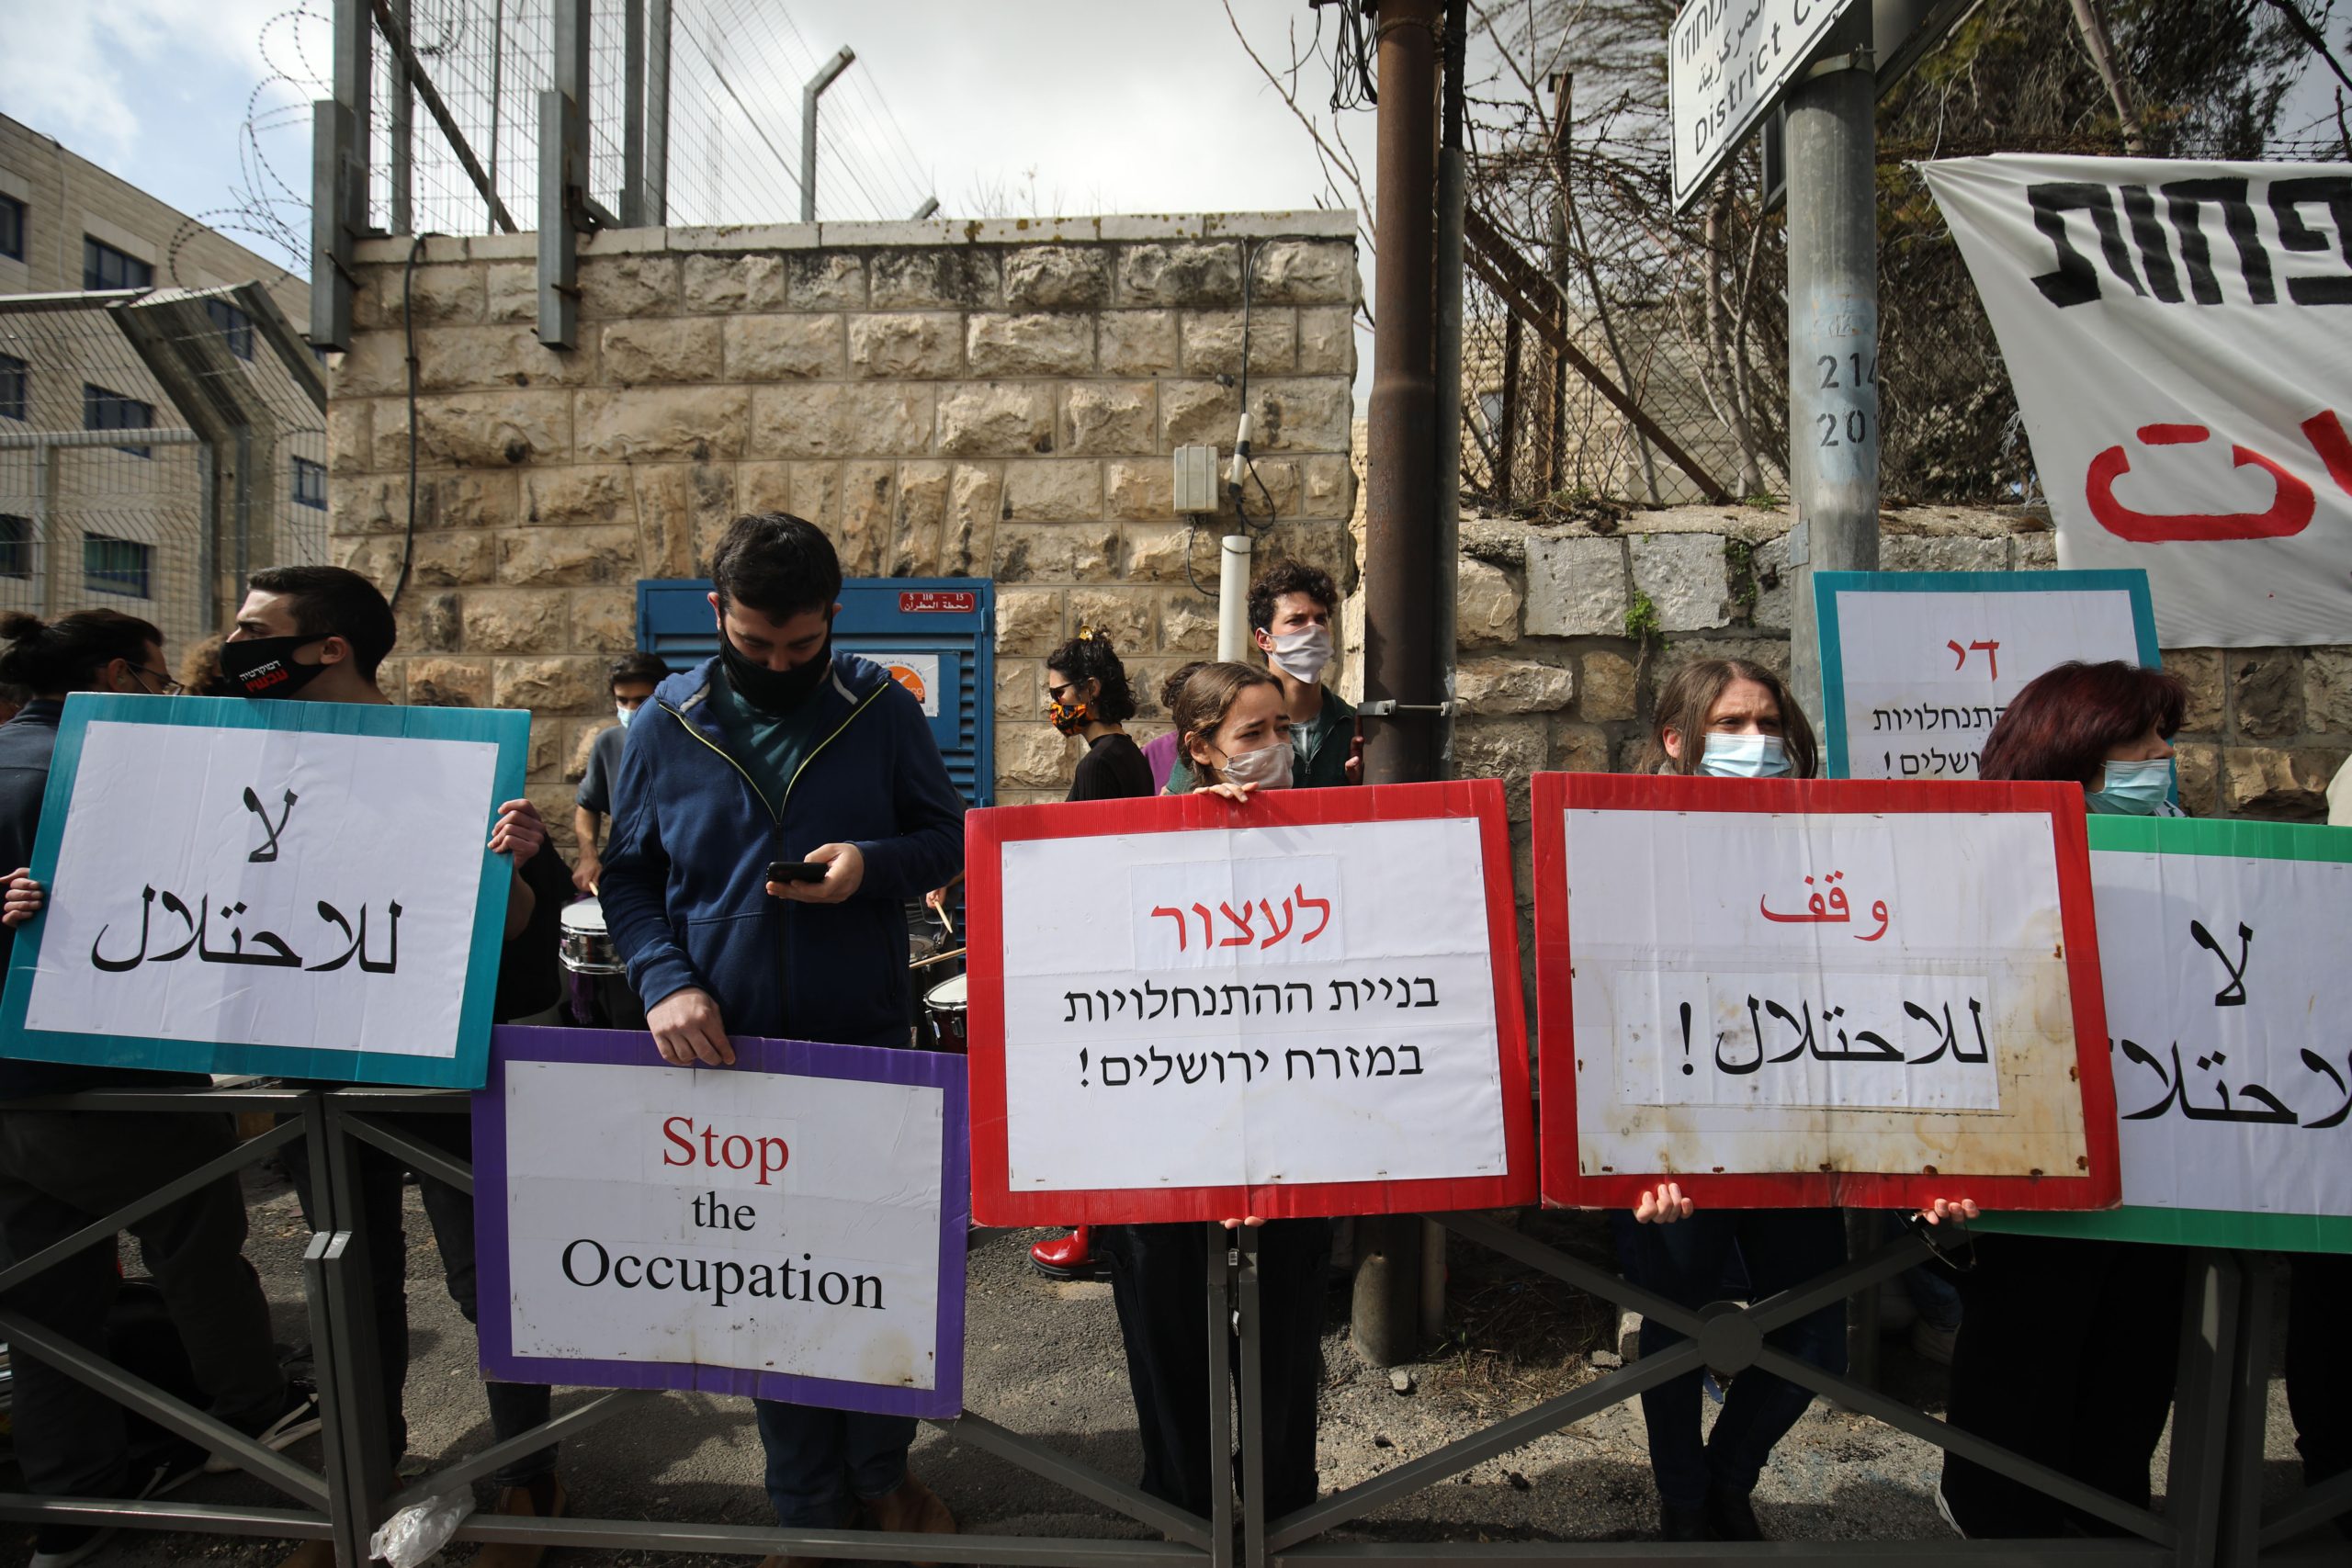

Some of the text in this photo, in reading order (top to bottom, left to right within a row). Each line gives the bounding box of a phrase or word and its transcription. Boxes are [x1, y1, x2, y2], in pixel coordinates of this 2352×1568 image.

[1680, 0, 1728, 65] מחוזי
[1695, 0, 1822, 155] District C
[904, 602, 939, 611] المطران
[239, 660, 281, 681] דמוקרטיה
[1947, 638, 2000, 682] די
[243, 786, 299, 863] لا
[91, 883, 403, 975] للاحتلال
[1151, 883, 1330, 953] לעצור
[1760, 870, 1889, 942] وقف
[2190, 919, 2254, 1006] لا
[1064, 976, 1440, 1022] בניית ההתנחלויות
[1079, 1043, 1424, 1088] במזרח ירושלים!
[662, 1116, 789, 1185] Stop
[691, 1190, 756, 1231] the
[561, 1239, 887, 1310] Occupation
